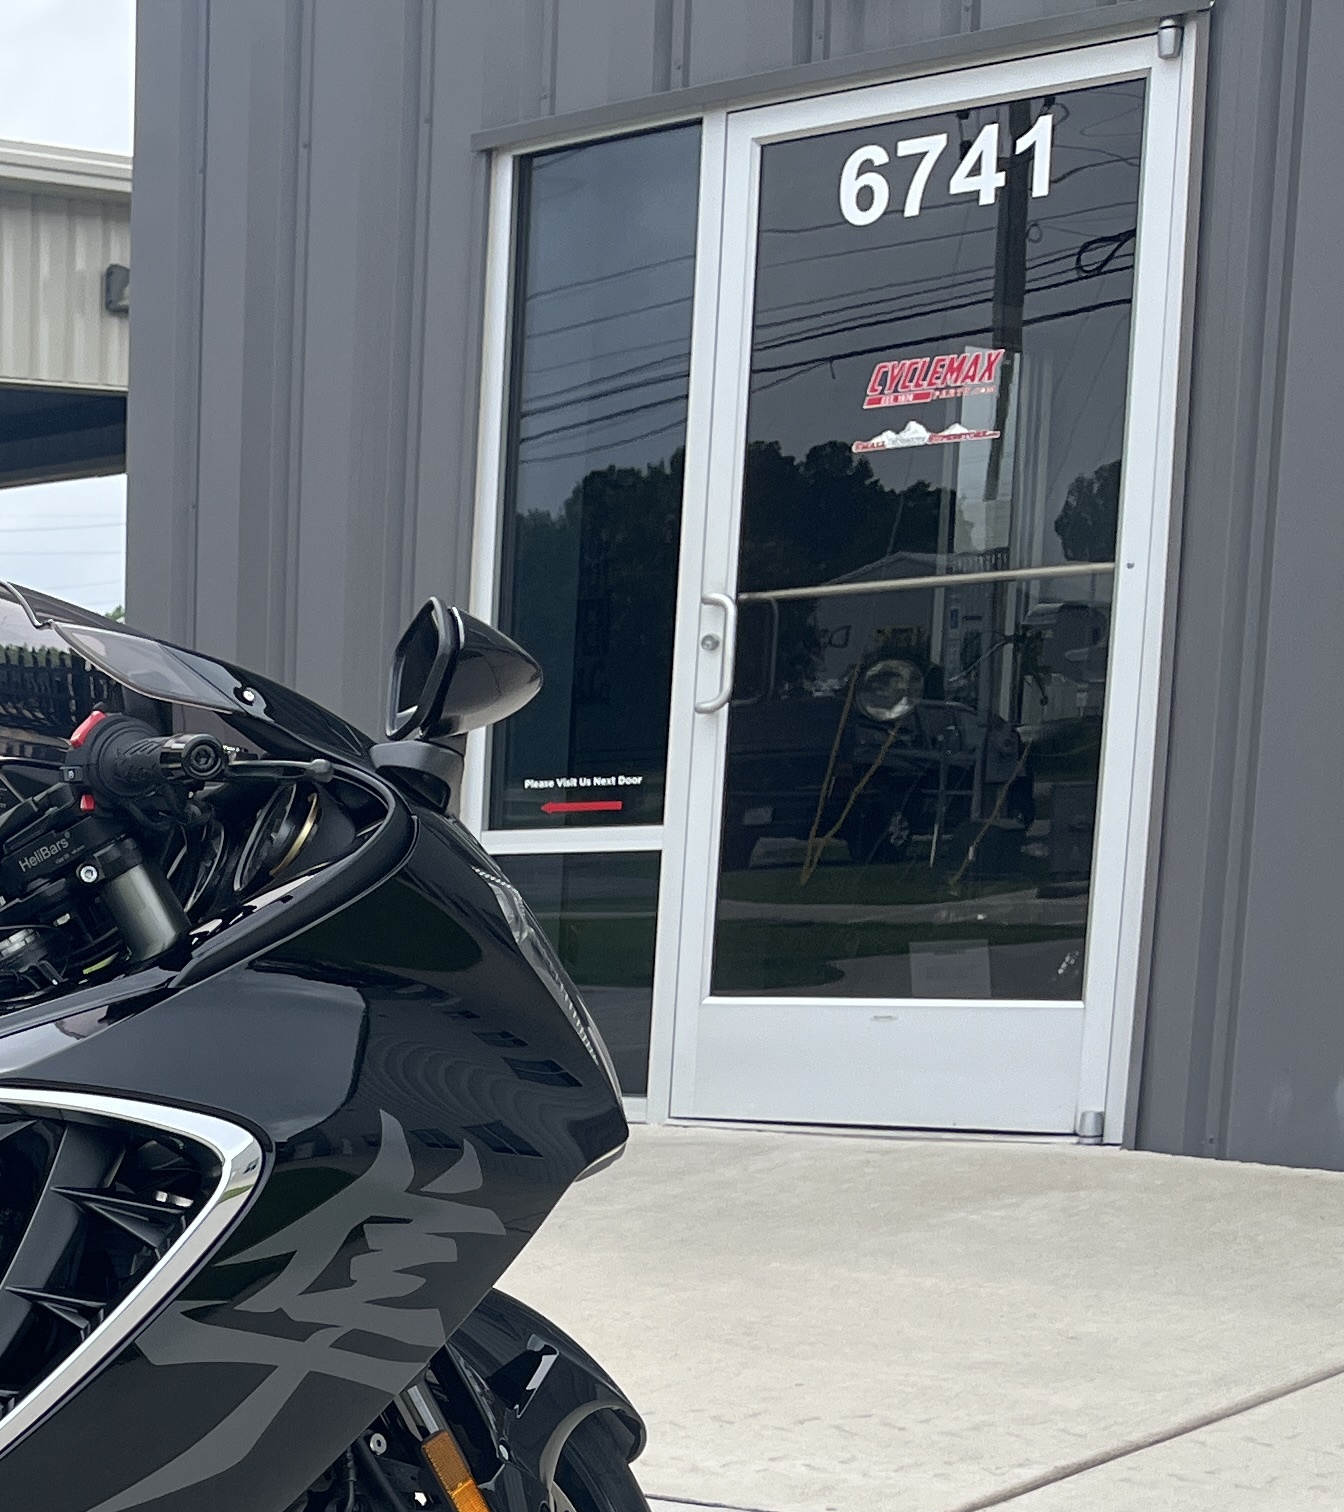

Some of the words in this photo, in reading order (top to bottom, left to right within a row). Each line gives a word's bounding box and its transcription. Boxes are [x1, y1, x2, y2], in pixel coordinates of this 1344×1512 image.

[838, 113, 1054, 227] 6741
[867, 349, 1005, 395] CYCLEMAX
[523, 779, 555, 789] Please
[556, 777, 578, 788] Visit
[578, 777, 592, 787] Us
[593, 776, 616, 787] Next
[617, 775, 643, 786] Door
